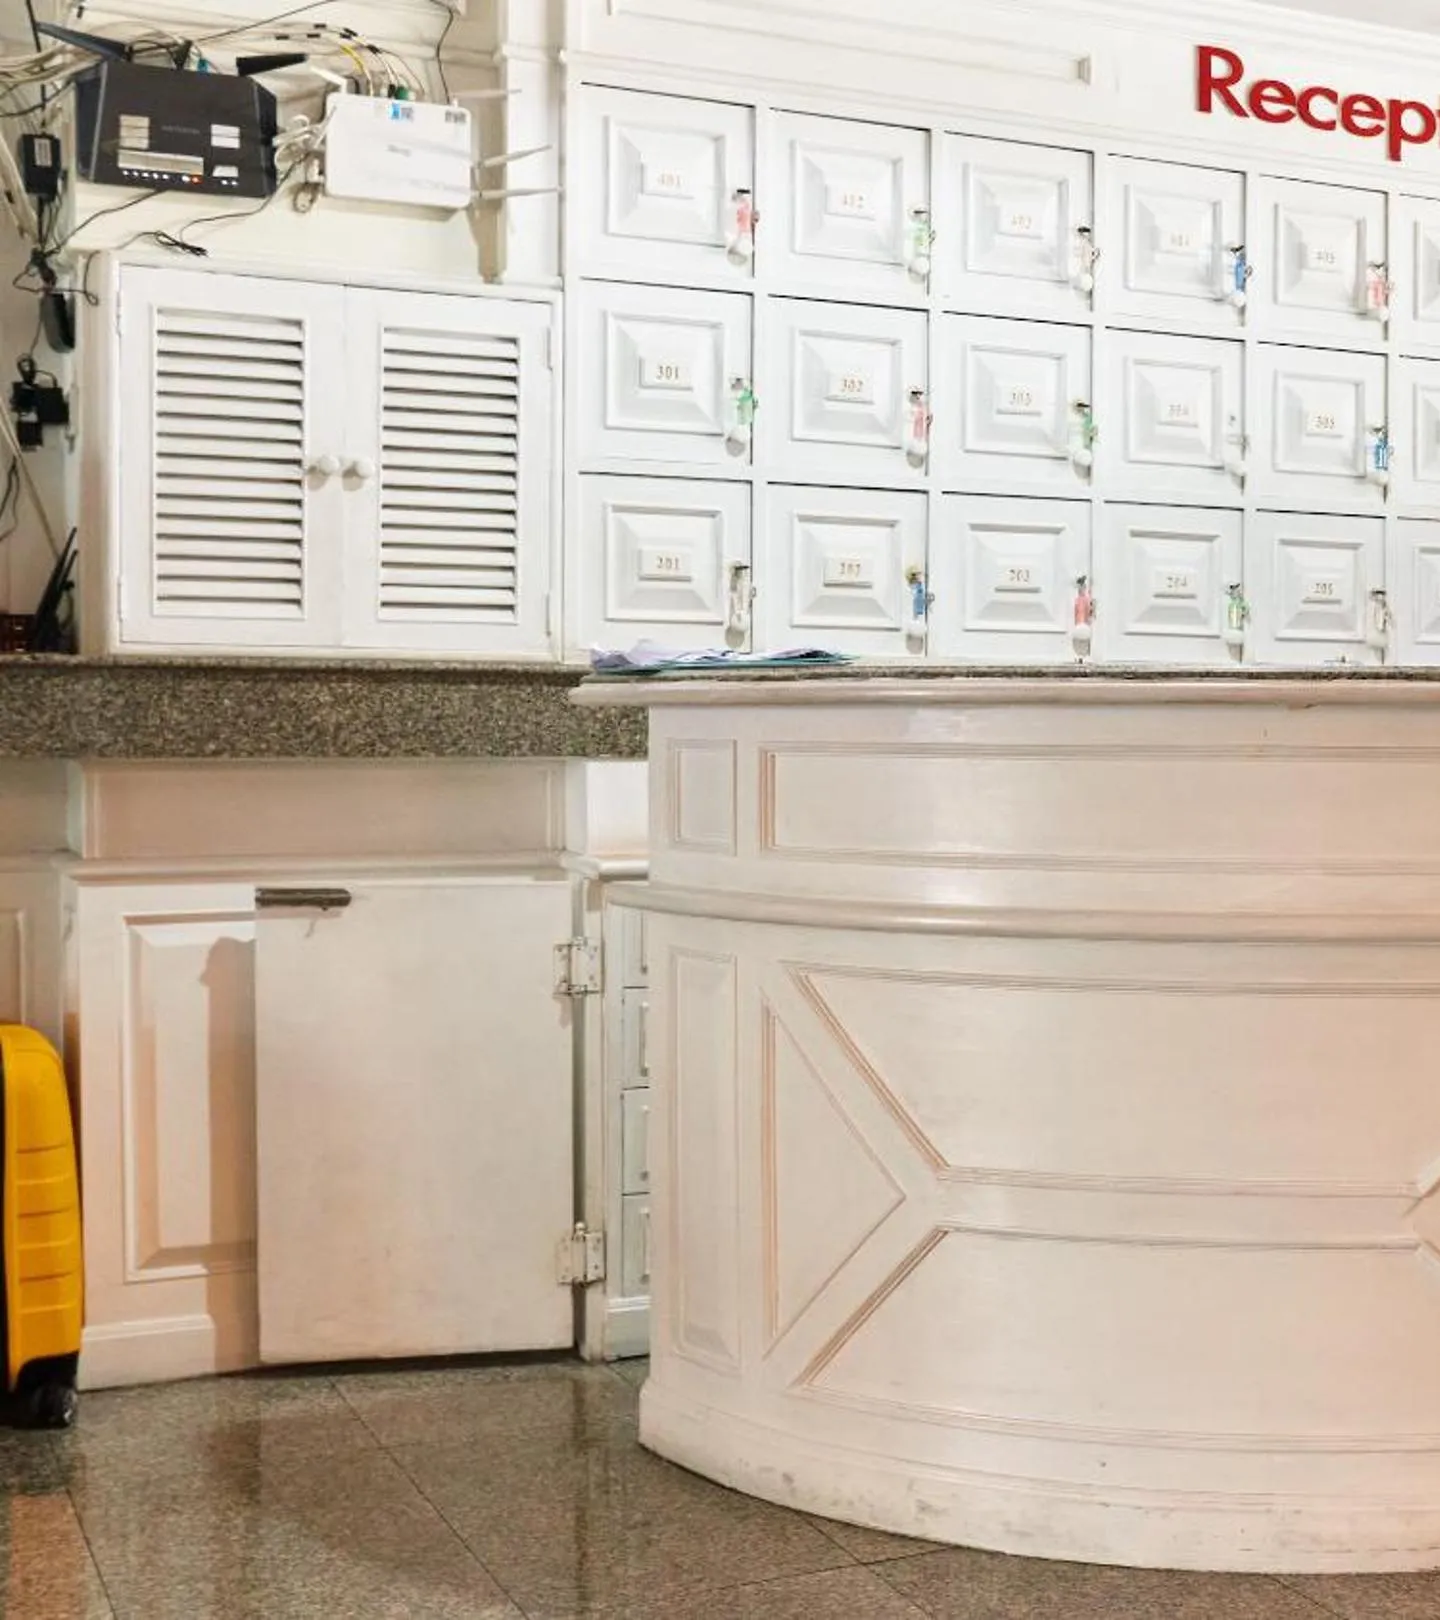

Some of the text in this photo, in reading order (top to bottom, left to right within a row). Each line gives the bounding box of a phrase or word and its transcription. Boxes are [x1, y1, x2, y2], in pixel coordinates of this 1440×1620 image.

[656, 365, 679, 380] 301
[841, 379, 864, 393] 302
[656, 555, 679, 570] 201
